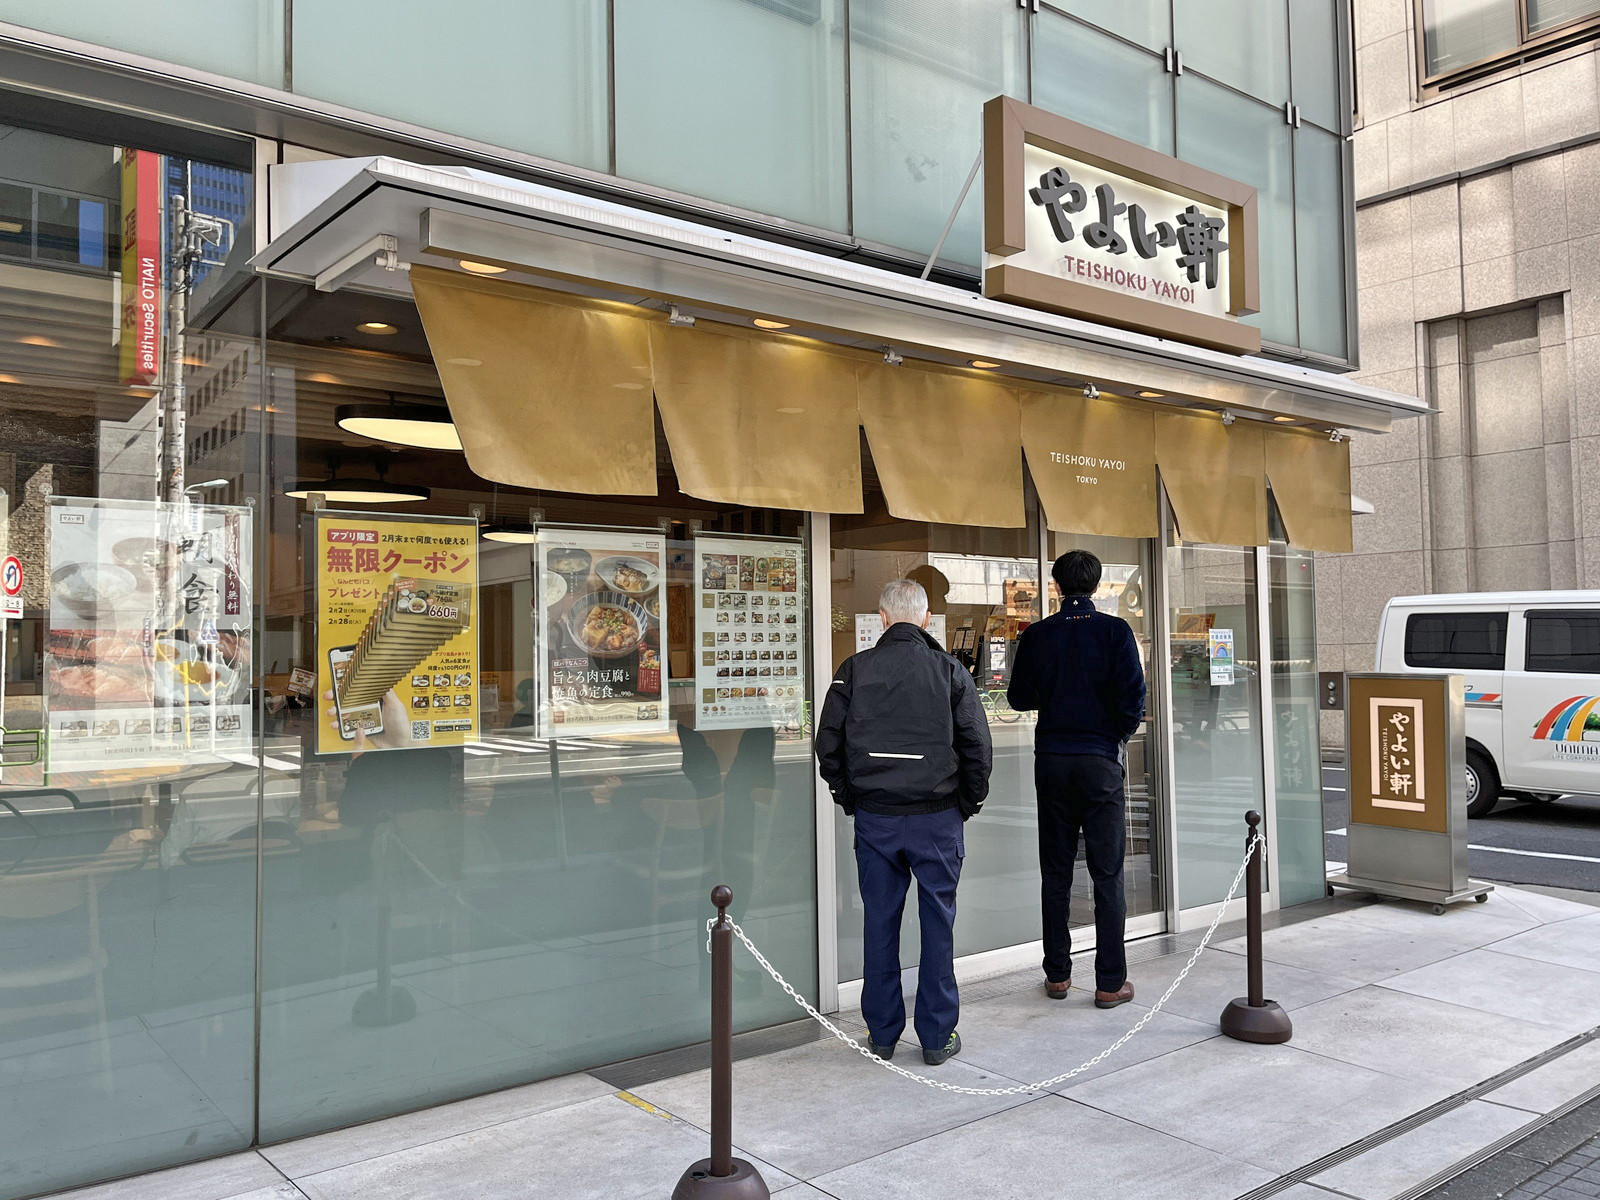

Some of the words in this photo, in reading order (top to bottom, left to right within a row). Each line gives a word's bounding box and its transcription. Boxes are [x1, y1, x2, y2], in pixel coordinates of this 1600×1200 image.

[1028, 166, 1229, 290] やよい軒
[1064, 255, 1147, 291] TEISHOKU
[1152, 278, 1195, 304] YAYOI
[1050, 451, 1097, 468] TEISHOKU
[1098, 458, 1126, 471] YAYOI
[1075, 475, 1098, 485] TOKYO
[330, 531, 375, 542] アプリ限定
[326, 546, 470, 574] 無限クーポン
[327, 587, 381, 600] プレゼント
[553, 669, 630, 685] 旨とろ肉豆腐と
[1389, 712, 1413, 796] やよい軒
